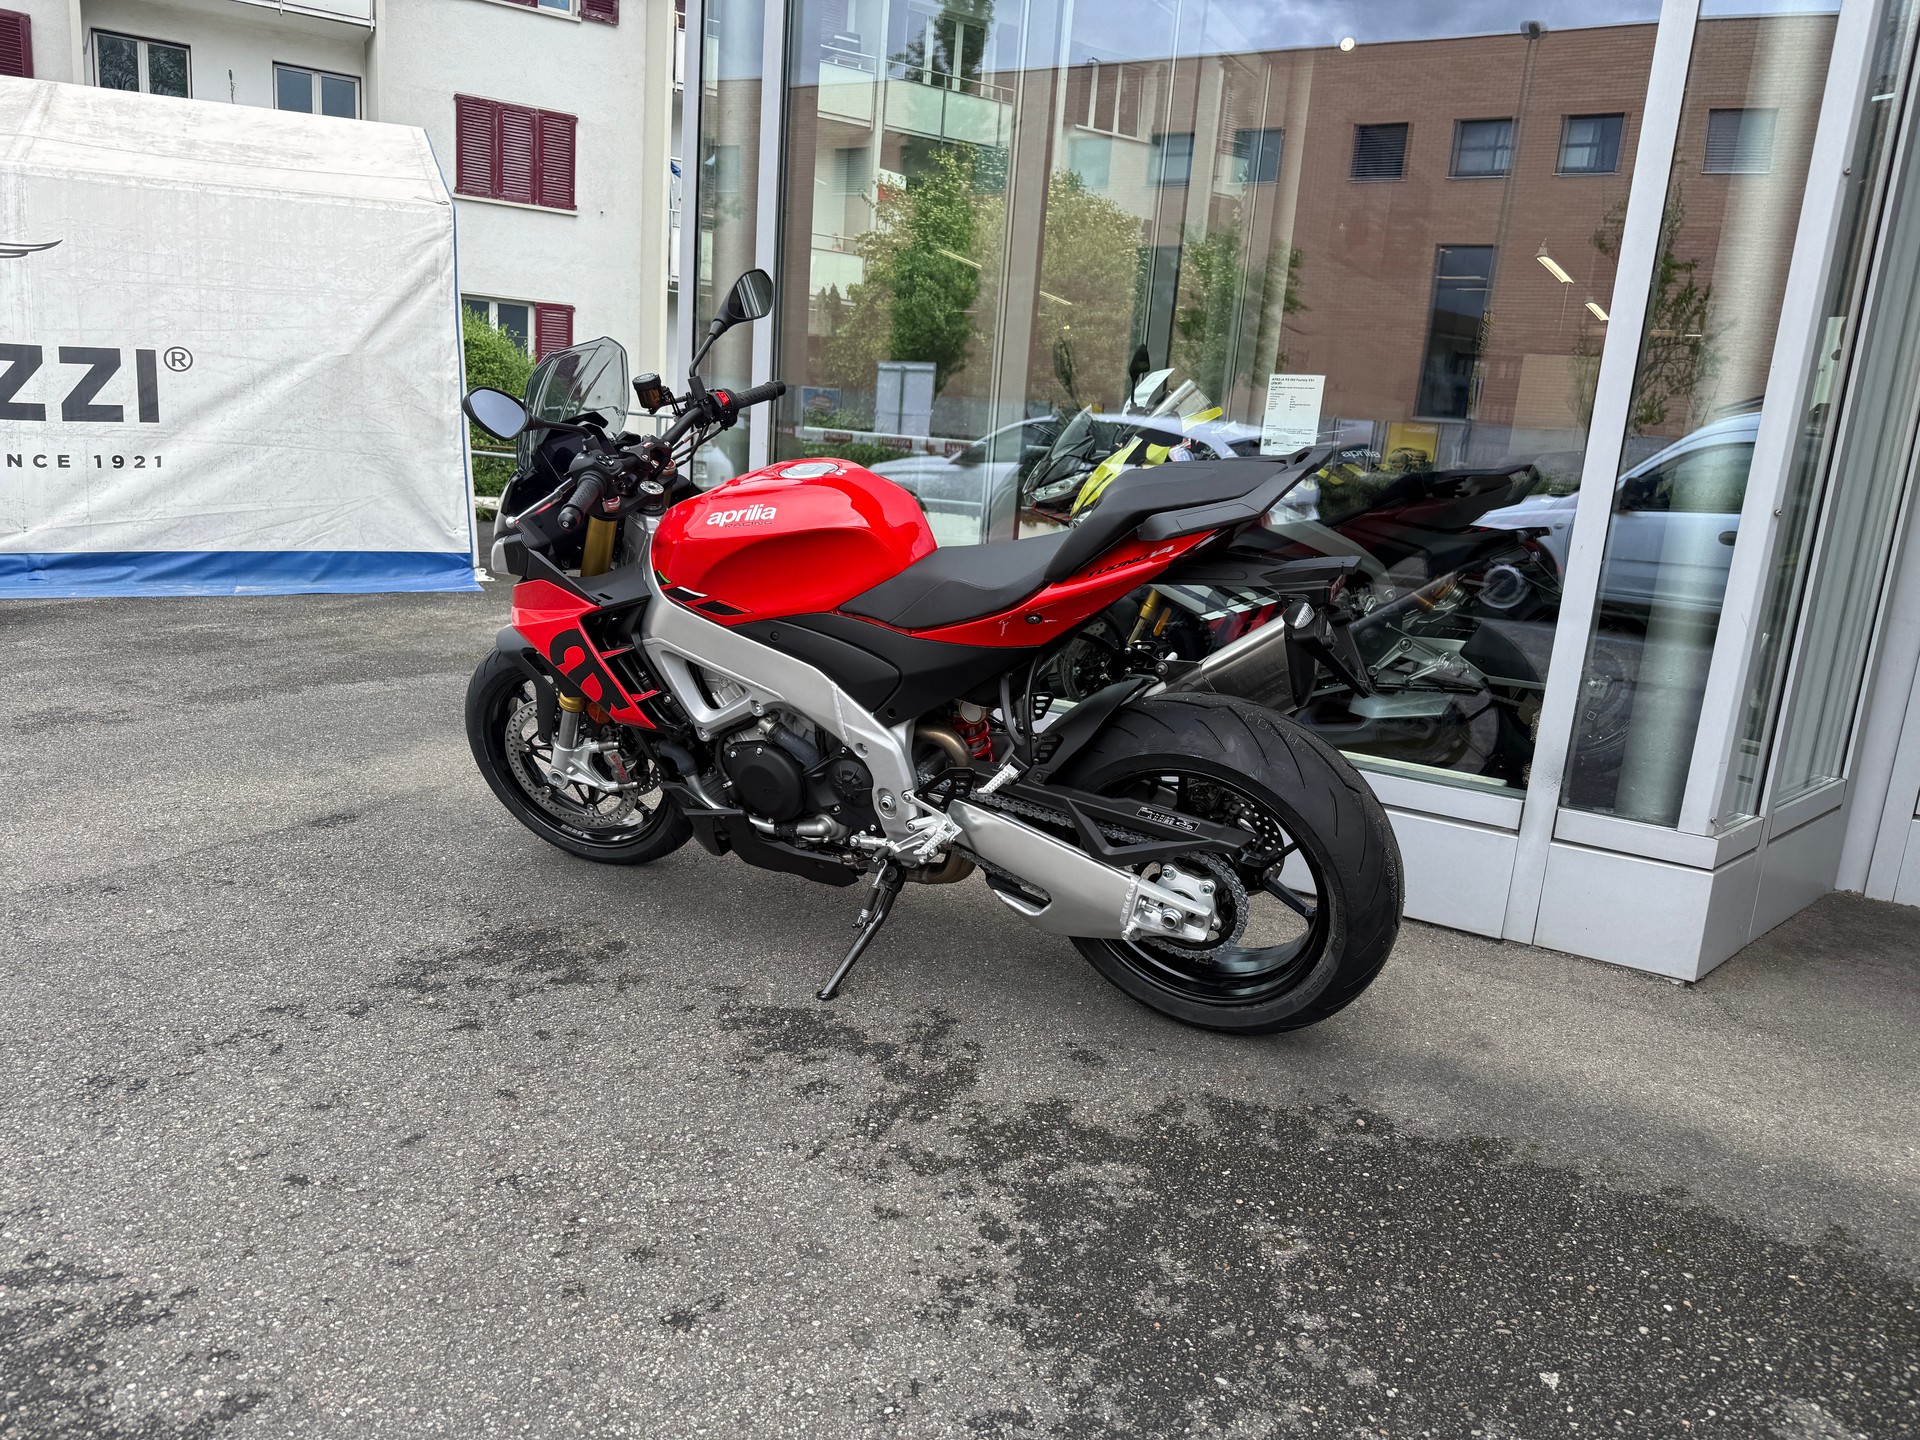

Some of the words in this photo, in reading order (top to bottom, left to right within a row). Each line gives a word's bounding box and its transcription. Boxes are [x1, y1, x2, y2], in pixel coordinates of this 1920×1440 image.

[93, 454, 162, 469] 1921
[1340, 449, 1381, 459] aprilia
[706, 503, 777, 527] aprilia
